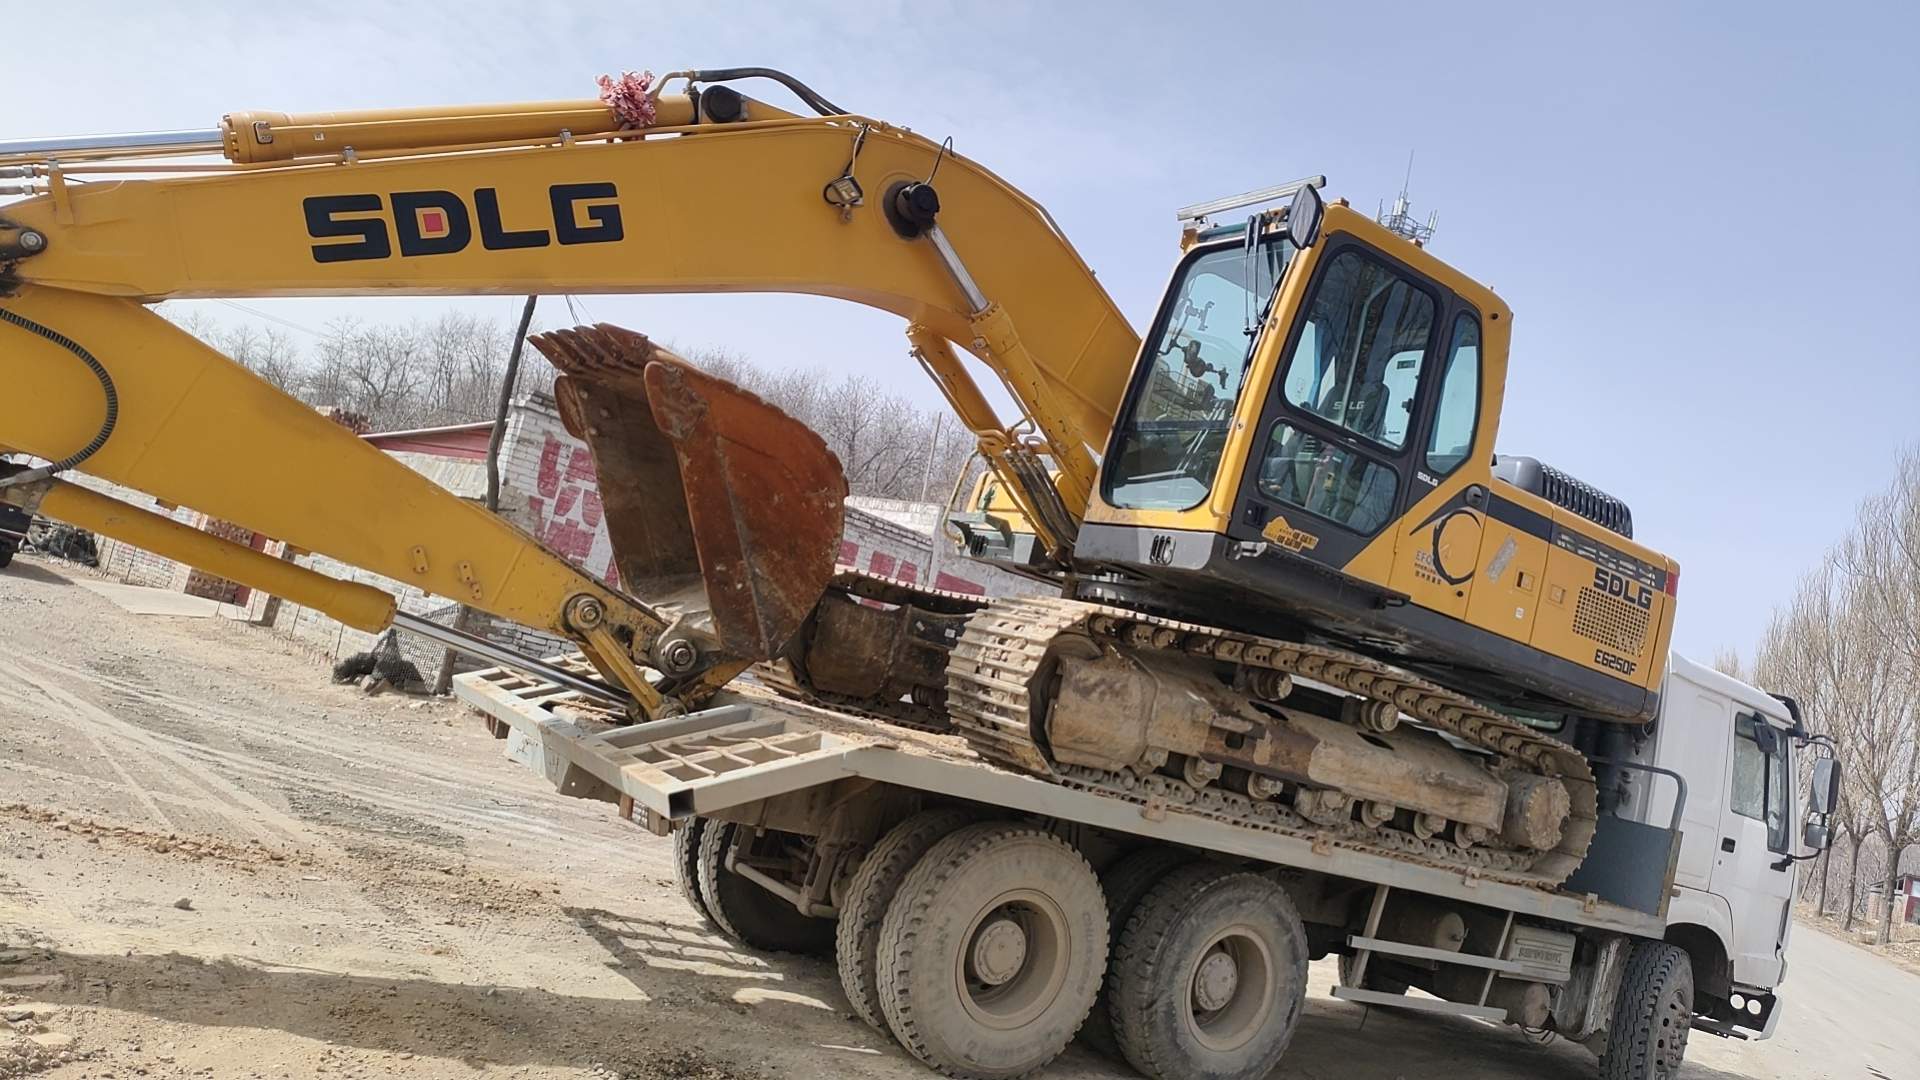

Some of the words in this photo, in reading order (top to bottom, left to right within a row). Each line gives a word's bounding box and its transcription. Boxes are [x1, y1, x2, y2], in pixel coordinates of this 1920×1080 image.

[303, 182, 624, 263] SDLG
[1333, 400, 1365, 410] SLG
[1417, 471, 1439, 487] SDLG
[1594, 567, 1652, 610] SDLG
[1595, 649, 1637, 676] E6250F
